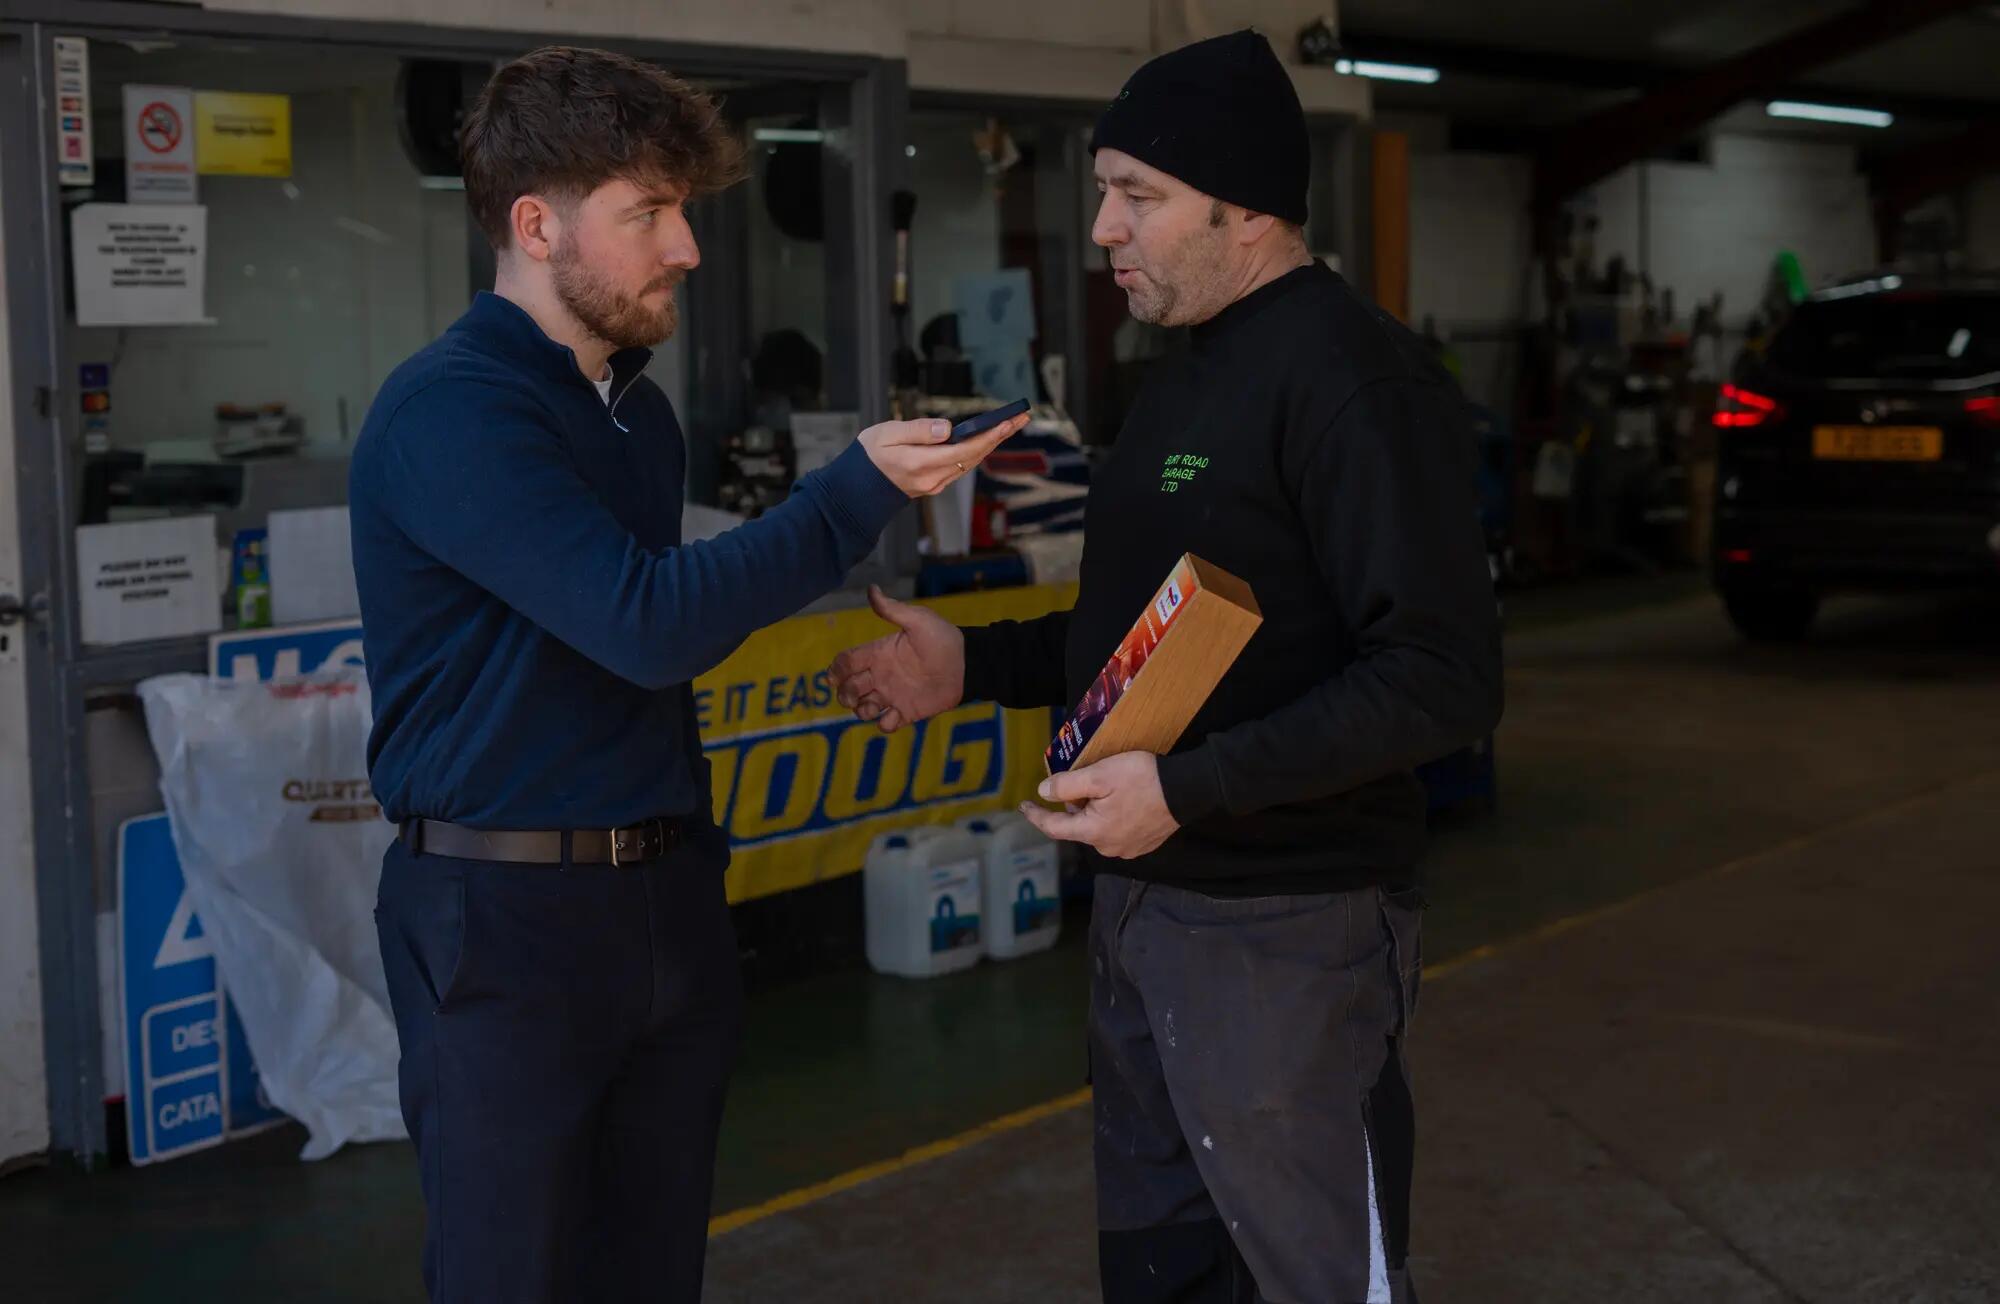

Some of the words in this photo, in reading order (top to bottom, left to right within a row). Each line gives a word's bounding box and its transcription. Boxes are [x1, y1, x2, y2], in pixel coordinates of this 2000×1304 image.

[1182, 454, 1208, 468] ROAD
[1162, 468, 1196, 480] GARAGE
[1161, 481, 1178, 492] LTD
[724, 681, 757, 724] IT
